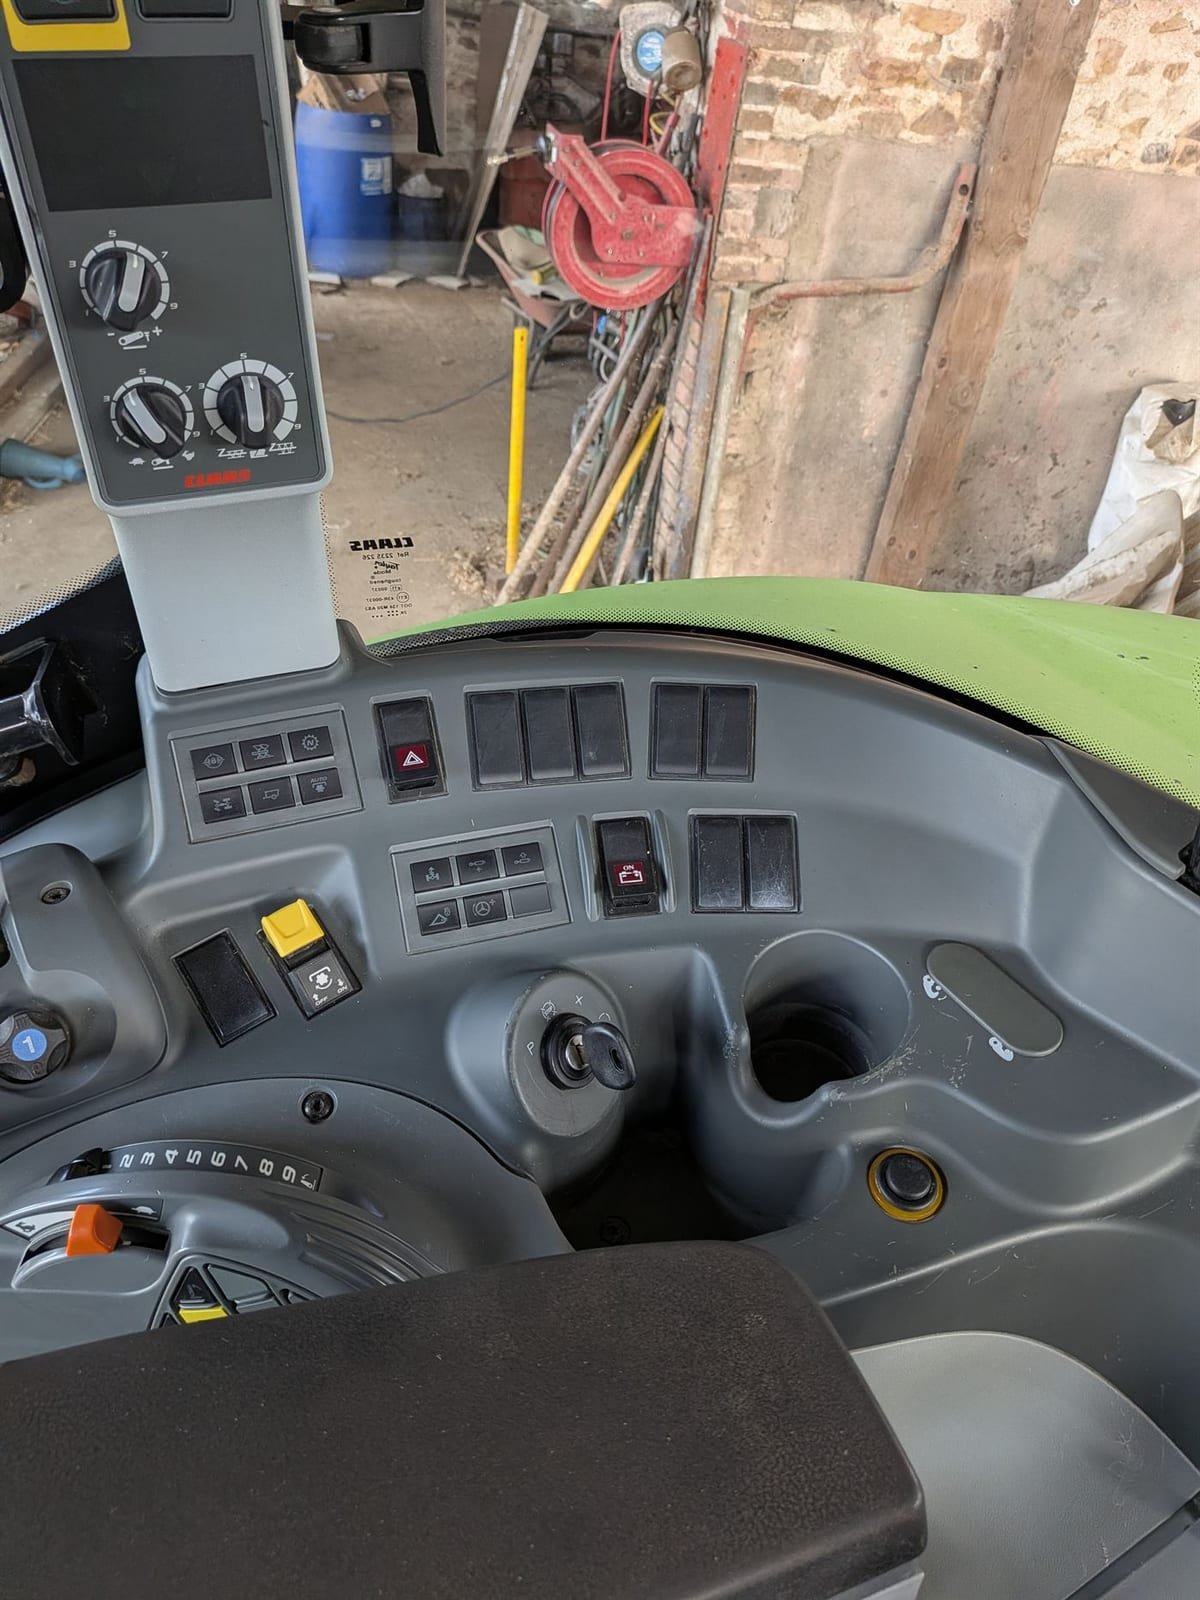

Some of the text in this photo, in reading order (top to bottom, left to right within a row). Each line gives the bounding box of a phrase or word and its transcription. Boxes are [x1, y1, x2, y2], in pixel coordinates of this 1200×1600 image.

[108, 229, 117, 238] 5
[160, 251, 168, 259] 7
[69, 260, 76, 268] 3
[170, 302, 178, 310] 9
[138, 368, 147, 376] 5
[184, 385, 193, 393] 7
[192, 430, 200, 438] 9
[311, 775, 328, 783] AUTO
[336, 984, 348, 994] ON
[314, 995, 329, 1007] OFF
[22, 1035, 36, 1054] 1
[526, 1041, 535, 1056] P
[119, 1149, 297, 1184] 2 3 4 5 6 7 8 9
